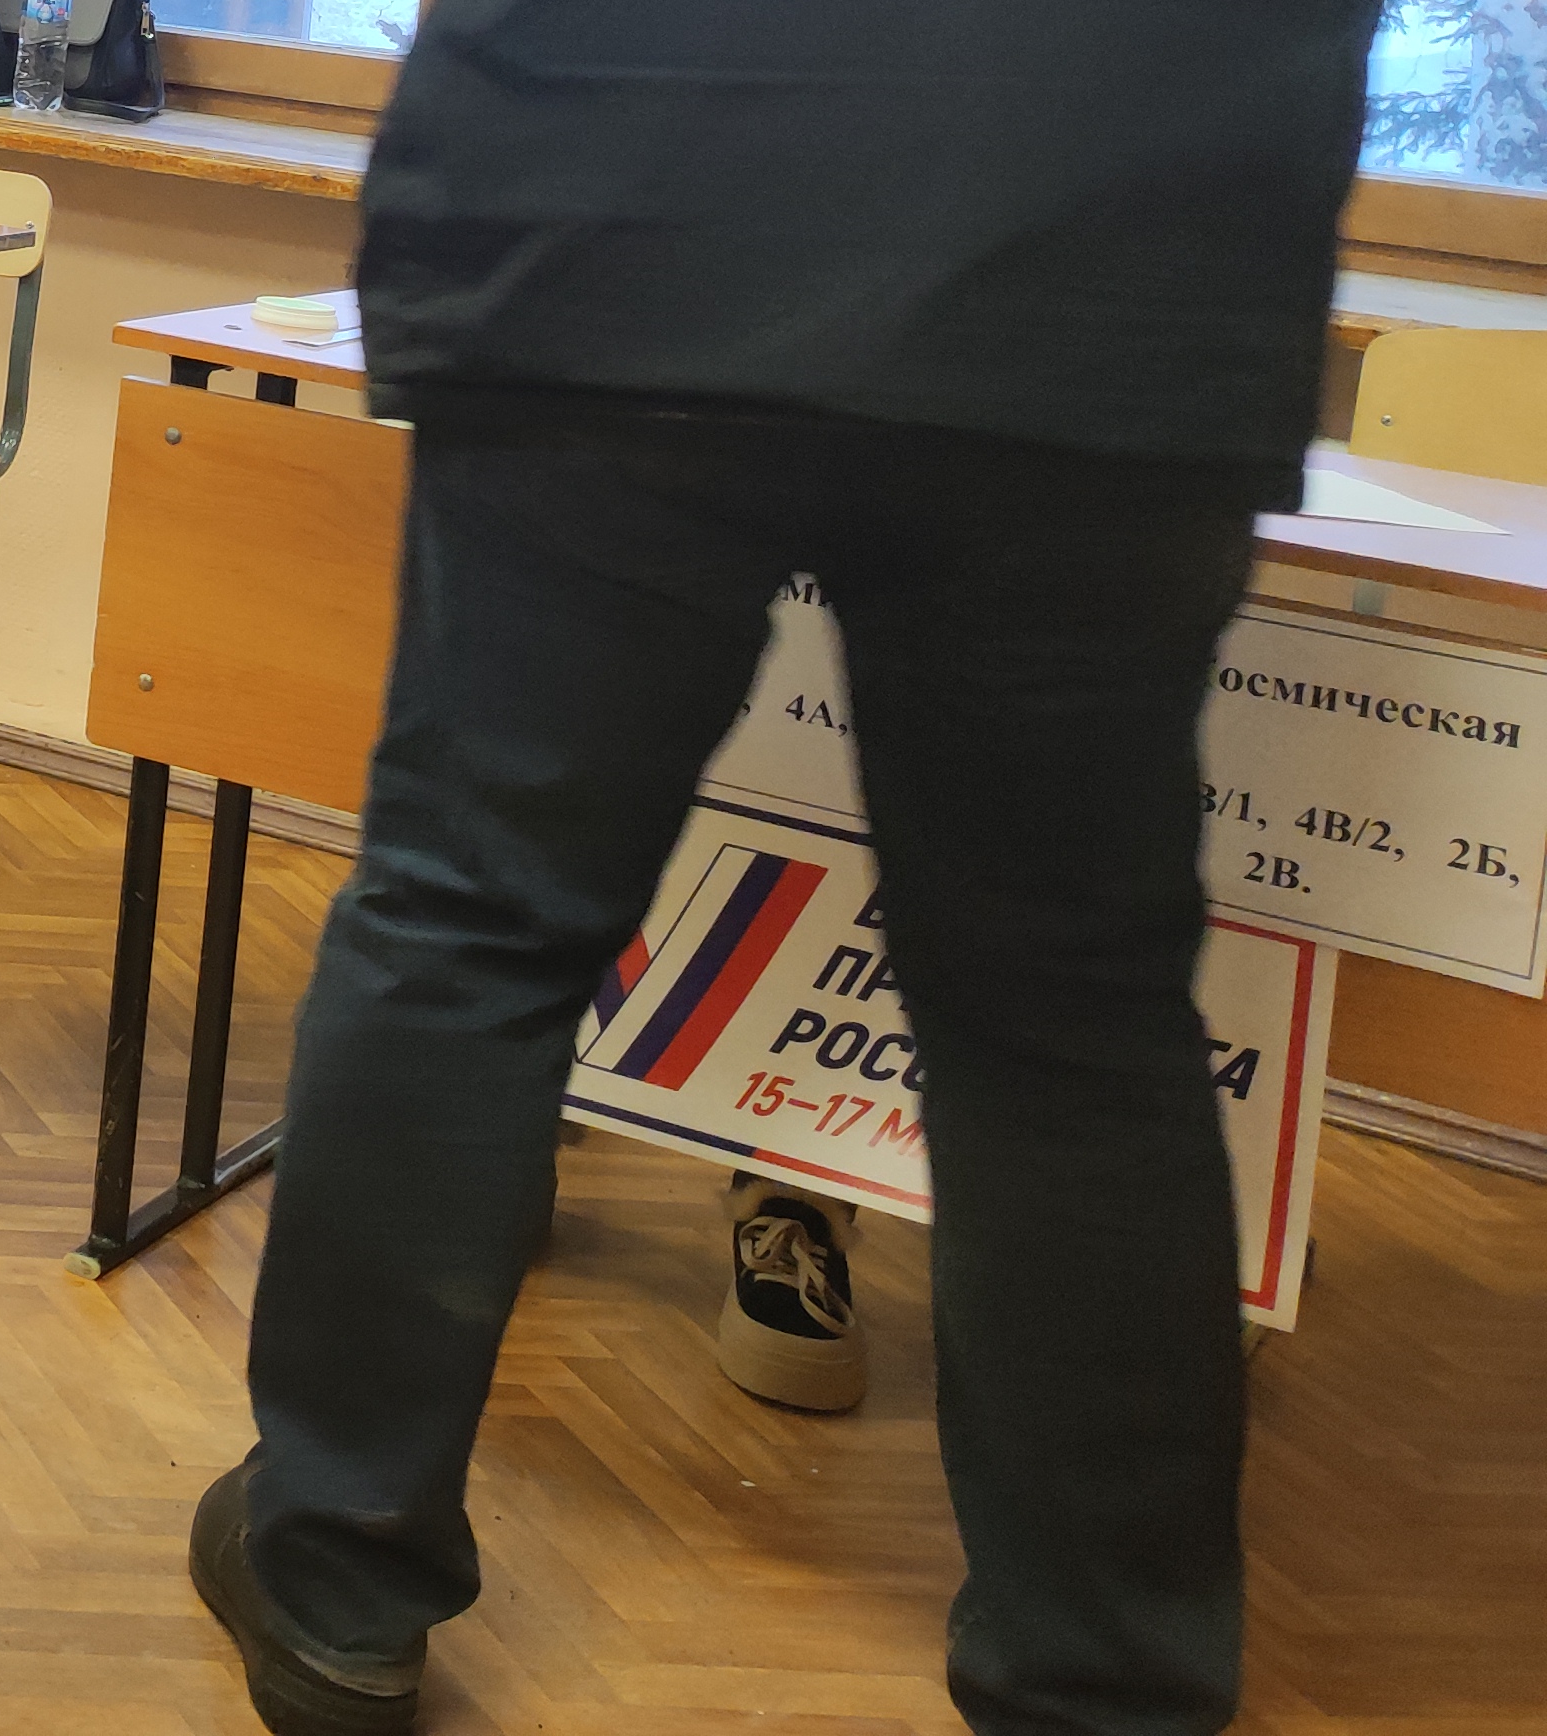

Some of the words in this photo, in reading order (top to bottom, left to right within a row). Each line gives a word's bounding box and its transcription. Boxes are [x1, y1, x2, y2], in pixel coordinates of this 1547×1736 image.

[1217, 666, 1521, 748] осмическая
[785, 694, 848, 737] 4А,
[1295, 807, 1405, 862] 4В/2,
[1447, 838, 1520, 888] 2Б,
[1243, 851, 1311, 893] 2В.
[769, 1008, 927, 1092] РОС
